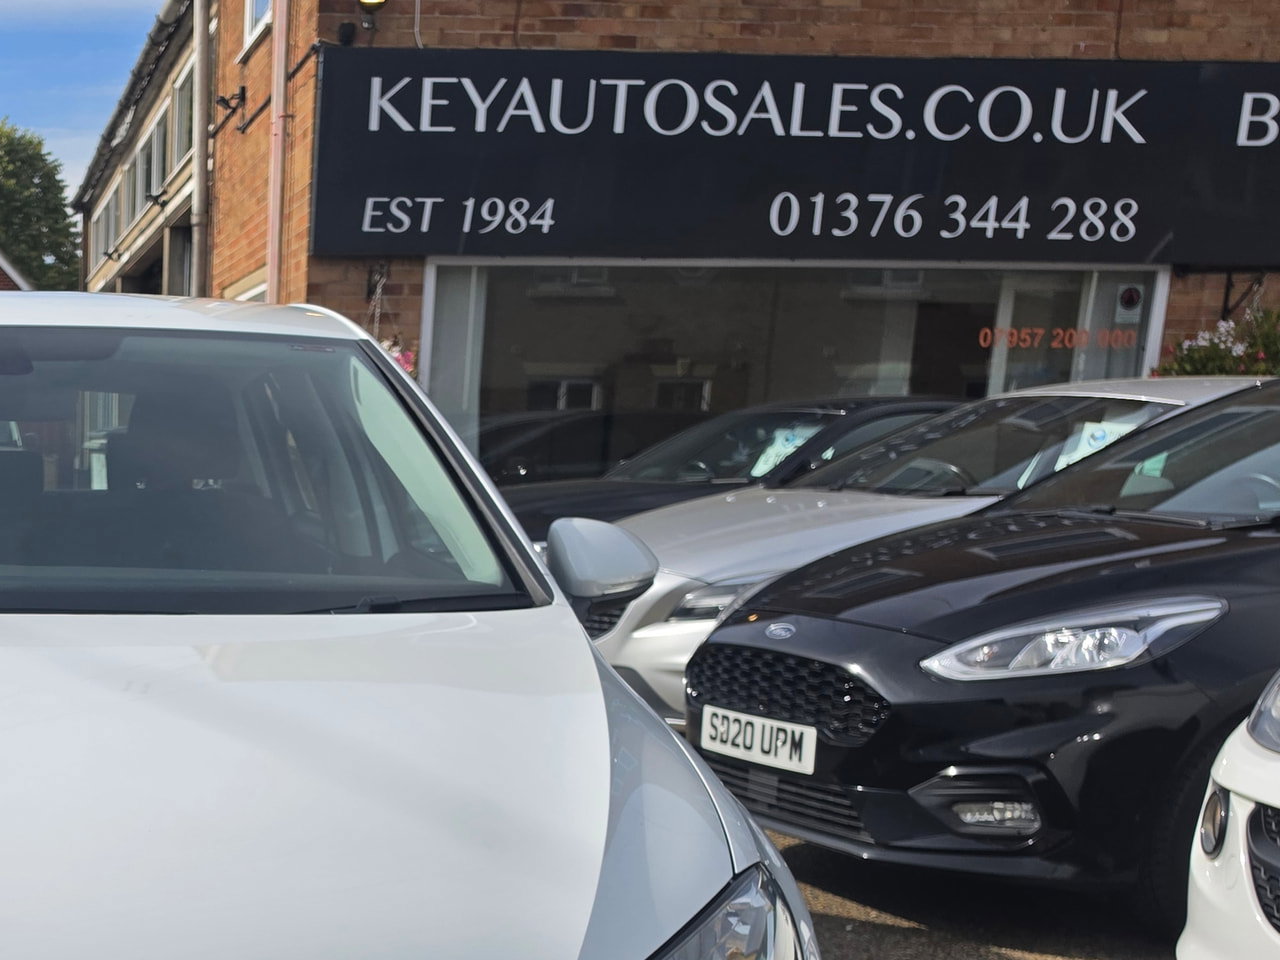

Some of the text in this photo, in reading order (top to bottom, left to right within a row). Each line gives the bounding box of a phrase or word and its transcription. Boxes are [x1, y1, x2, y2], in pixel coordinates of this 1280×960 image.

[366, 76, 1148, 145] KEYAUTOSALES.CO.UK
[361, 197, 556, 235] EST 1984
[769, 191, 1139, 242] 01376 344 288
[761, 724, 804, 763] UPM
